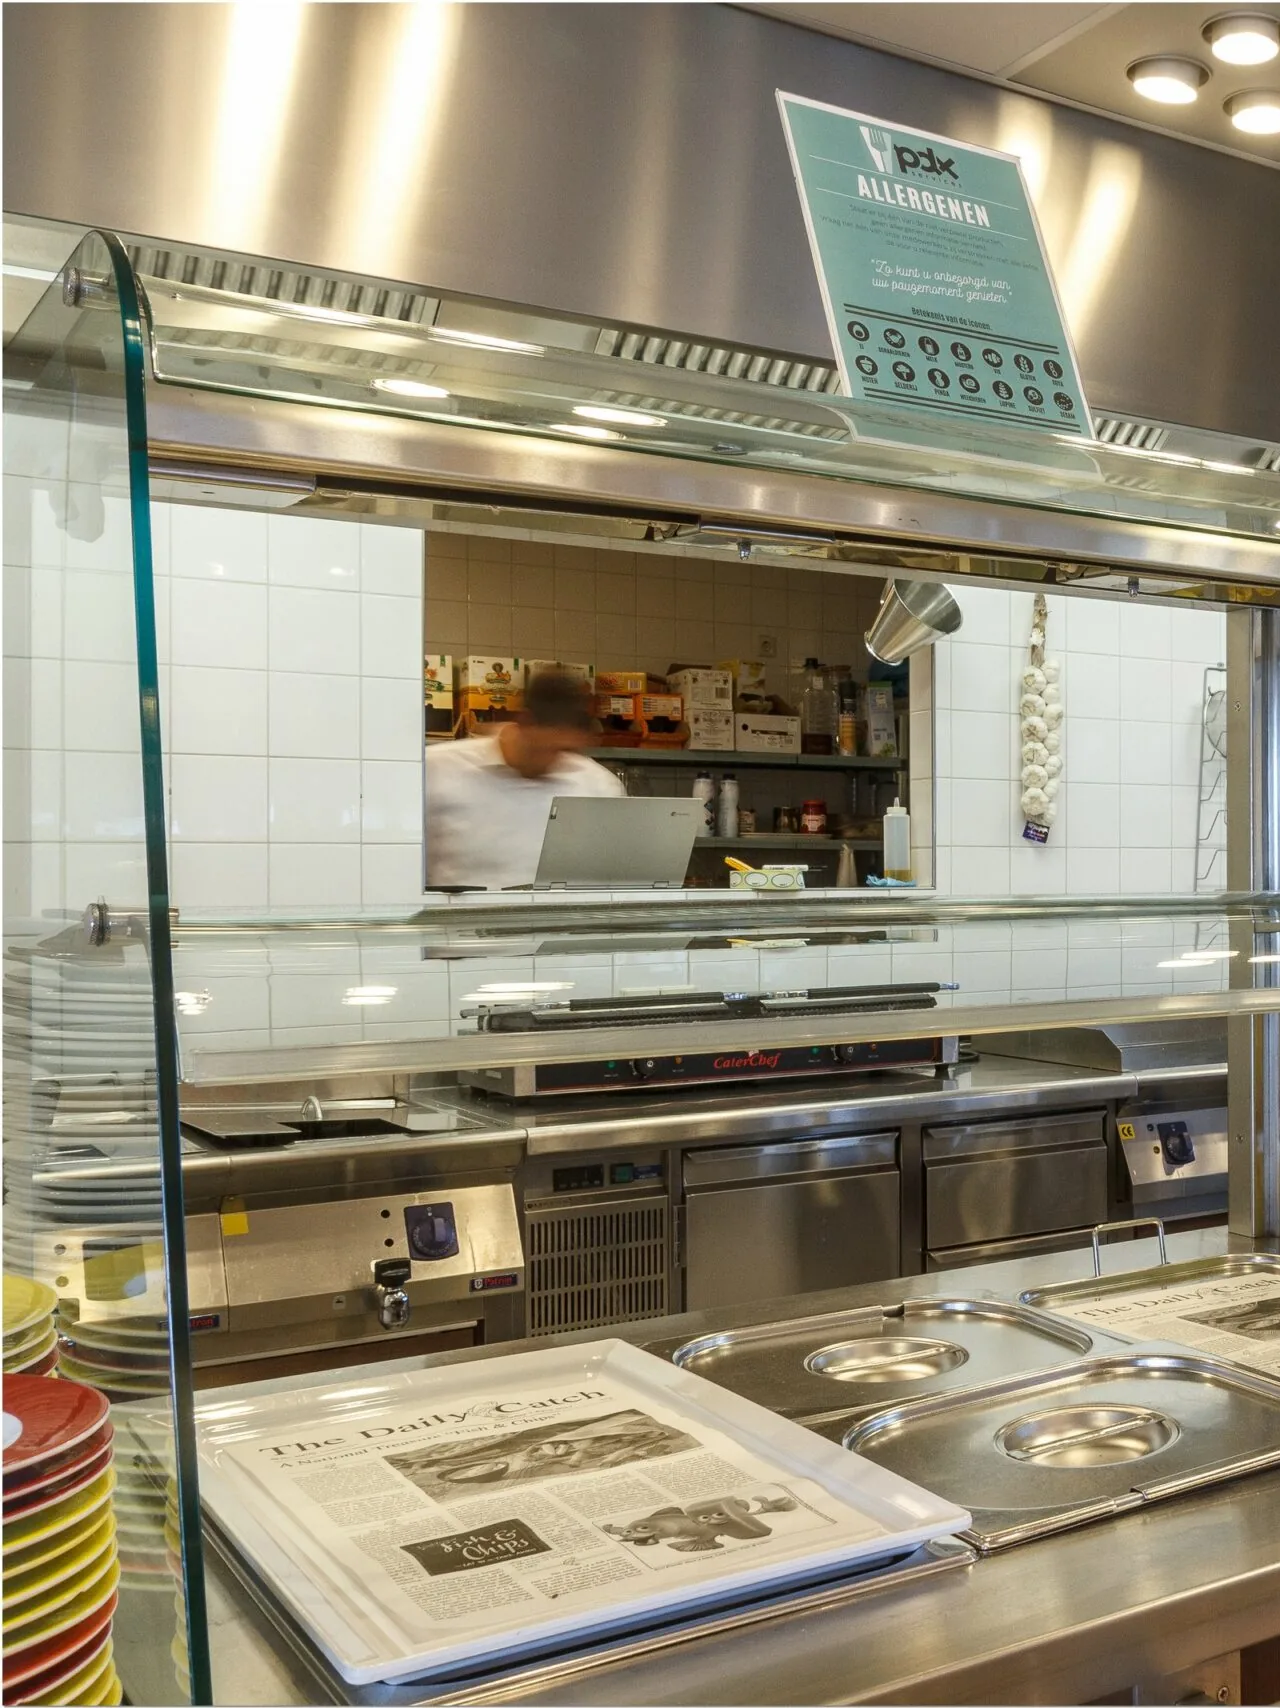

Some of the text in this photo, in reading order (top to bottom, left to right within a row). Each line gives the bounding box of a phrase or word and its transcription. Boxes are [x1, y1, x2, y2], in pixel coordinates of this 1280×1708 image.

[893, 143, 960, 180] pdx
[857, 174, 991, 228] ALLERGENEN
[895, 263, 921, 279] kunt
[923, 270, 931, 280] u
[934, 271, 989, 290] onbezorgd
[891, 281, 964, 299] pauzemoment
[911, 307, 945, 322] Betekenis
[945, 314, 959, 324] van
[959, 317, 968, 326] de
[713, 1053, 782, 1069] CaterChef
[1074, 1304, 1132, 1318] The
[1133, 1287, 1204, 1309] Daily
[259, 1389, 606, 1458] The Daily Catch
[297, 1447, 370, 1466] National
[440, 1534, 491, 1554] Fish
[494, 1529, 517, 1542] &
[462, 1538, 530, 1562] Chips
